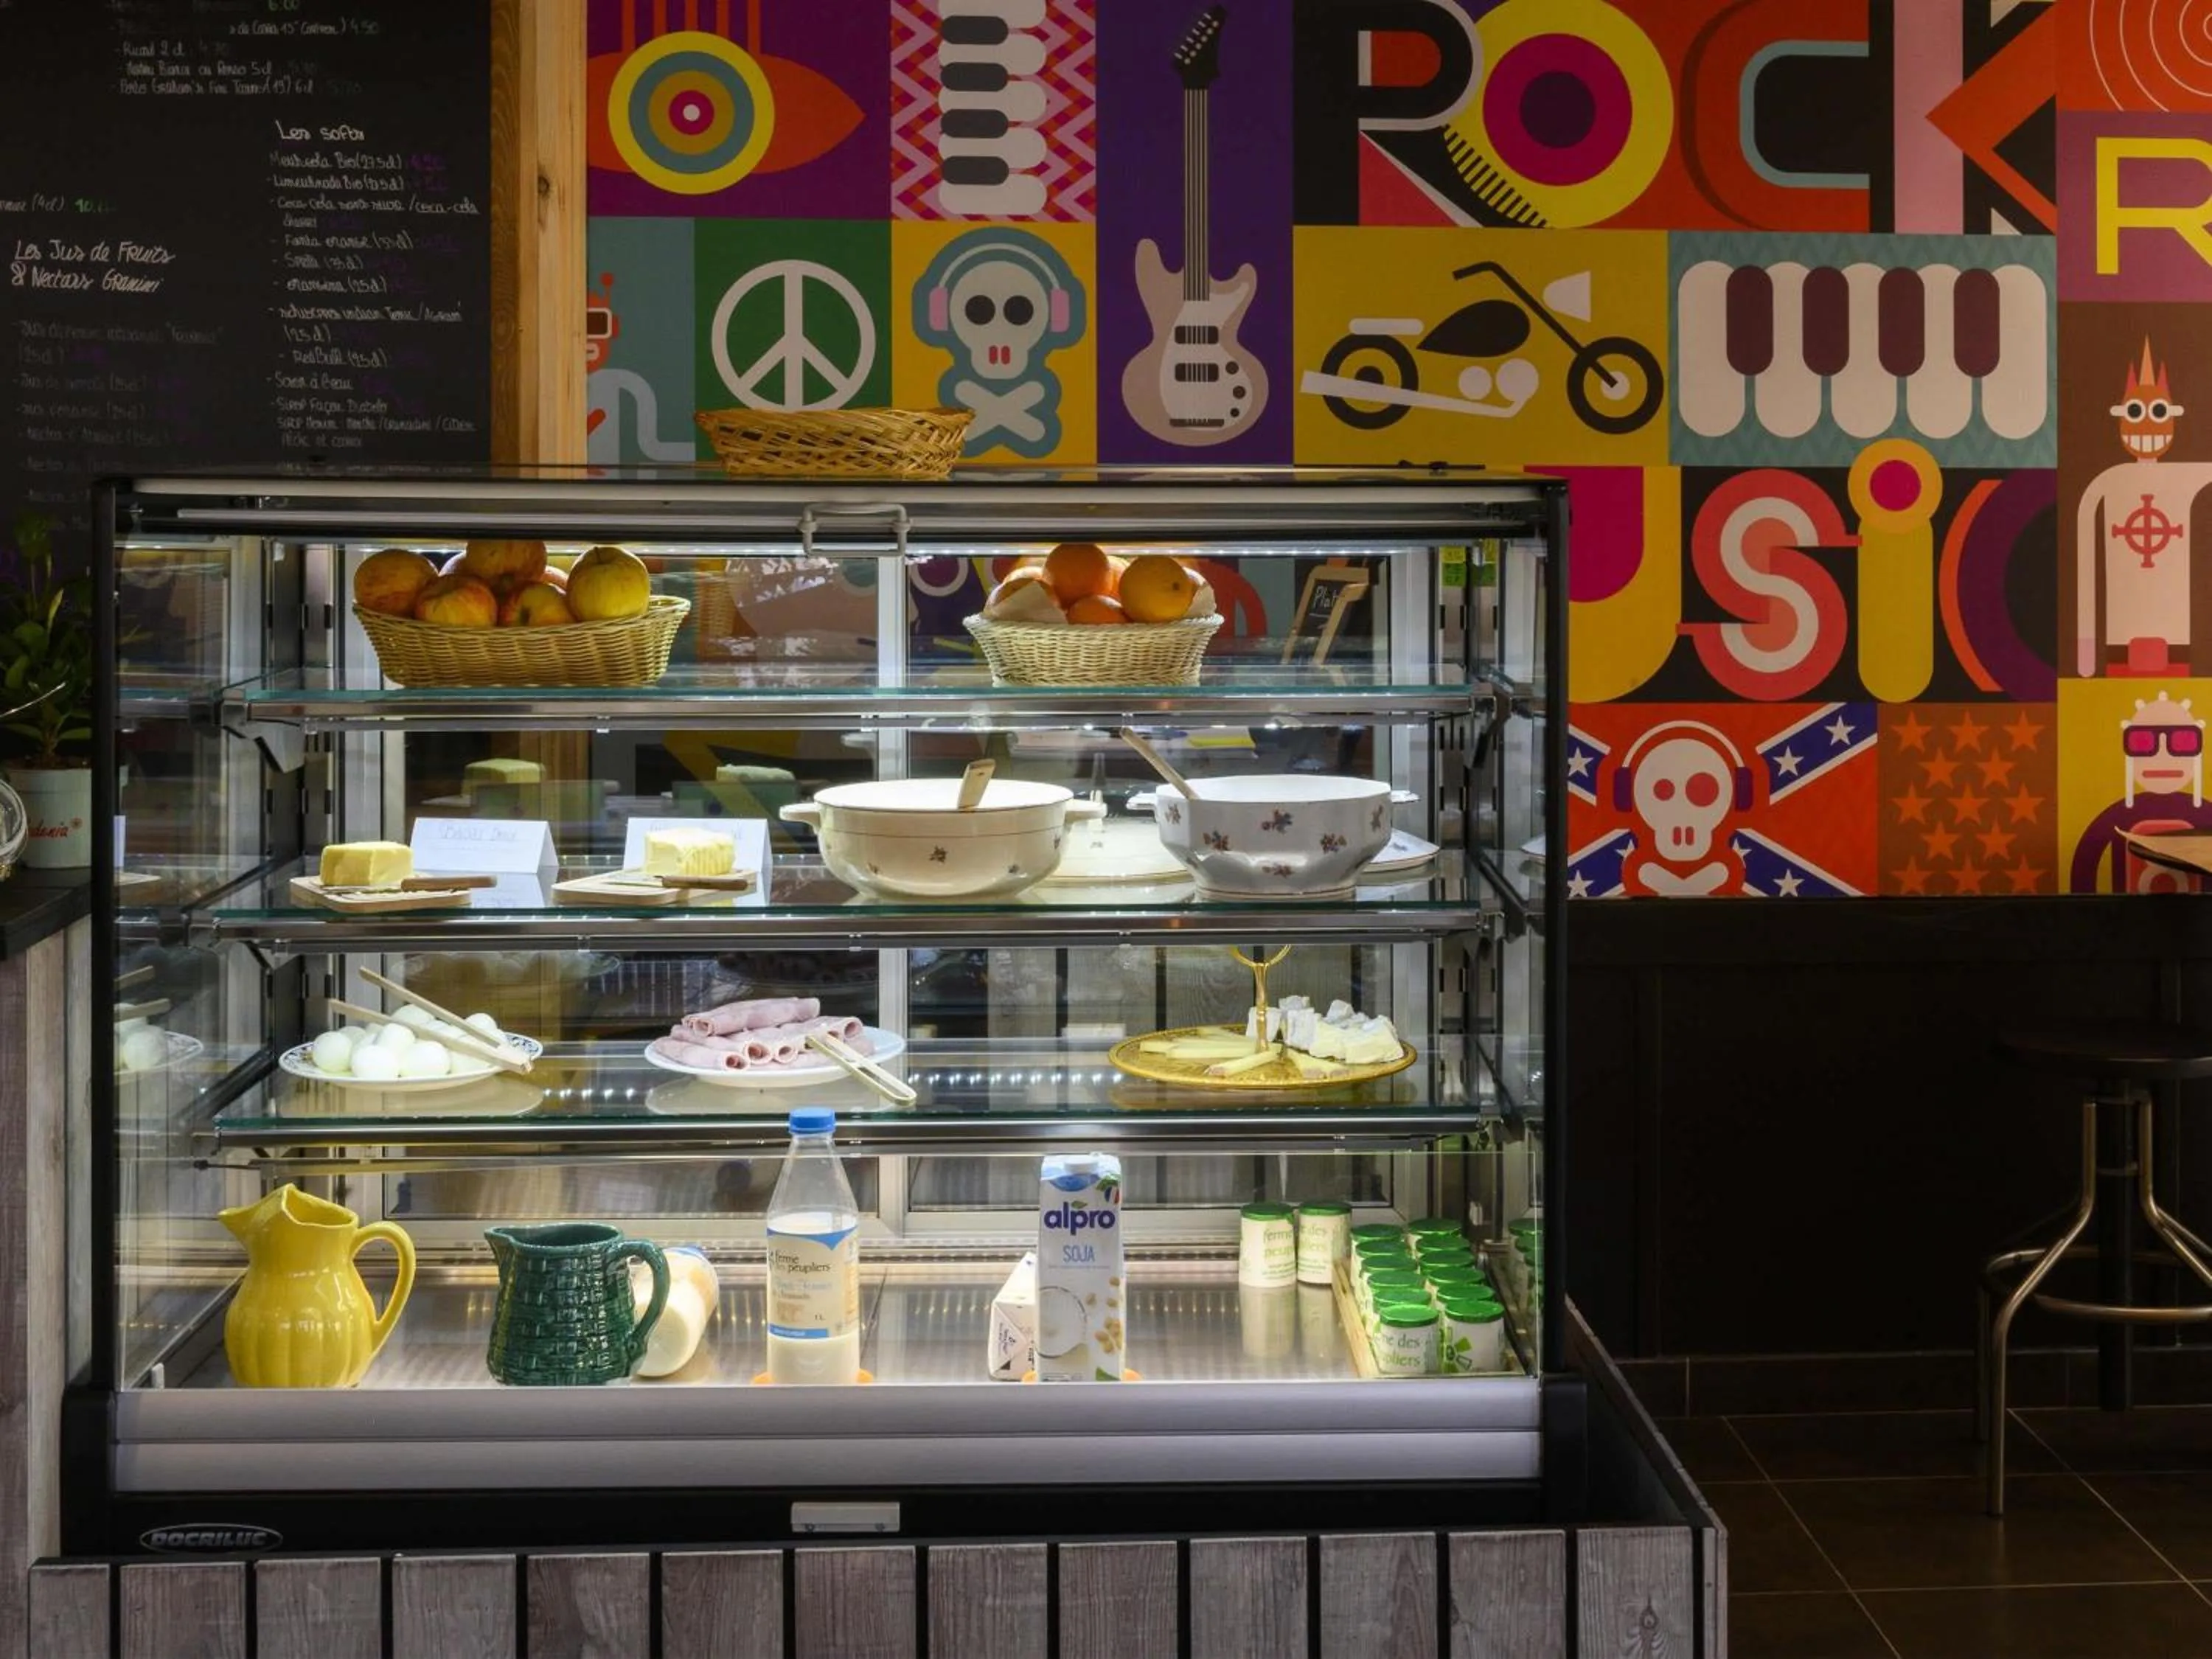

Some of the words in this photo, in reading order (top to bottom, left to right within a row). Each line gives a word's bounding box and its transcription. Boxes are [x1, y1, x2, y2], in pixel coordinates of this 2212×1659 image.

[1294, 0, 2057, 234] ROCK
[14, 239, 43, 260] Les
[48, 239, 86, 262] Jus
[90, 241, 110, 262] de
[1043, 1200, 1116, 1236] alpro
[1062, 1244, 1096, 1263] SOJA
